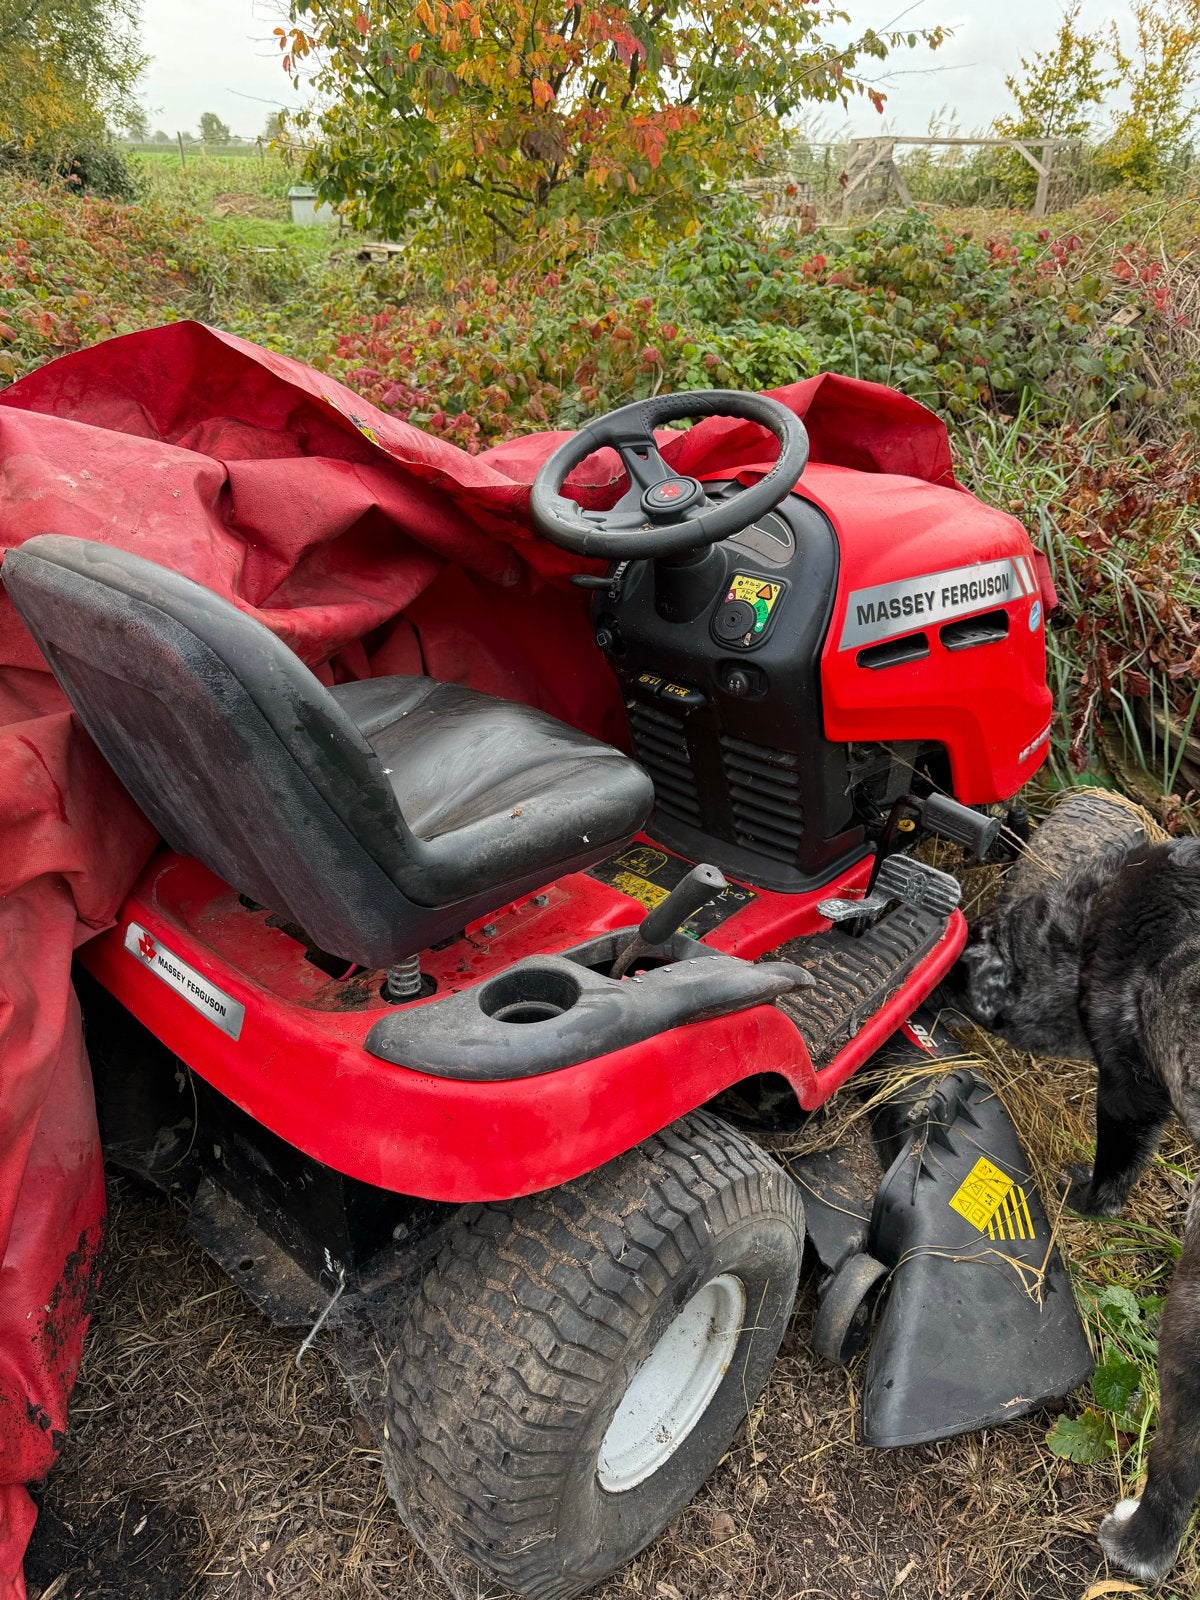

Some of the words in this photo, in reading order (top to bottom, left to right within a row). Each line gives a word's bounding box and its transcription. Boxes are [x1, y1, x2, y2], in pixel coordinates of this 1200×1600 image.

[856, 591, 935, 626] MASSEY
[941, 573, 1009, 608] FERGUSON
[158, 956, 186, 984] MASSEY
[187, 981, 227, 1017] FERGUSON
